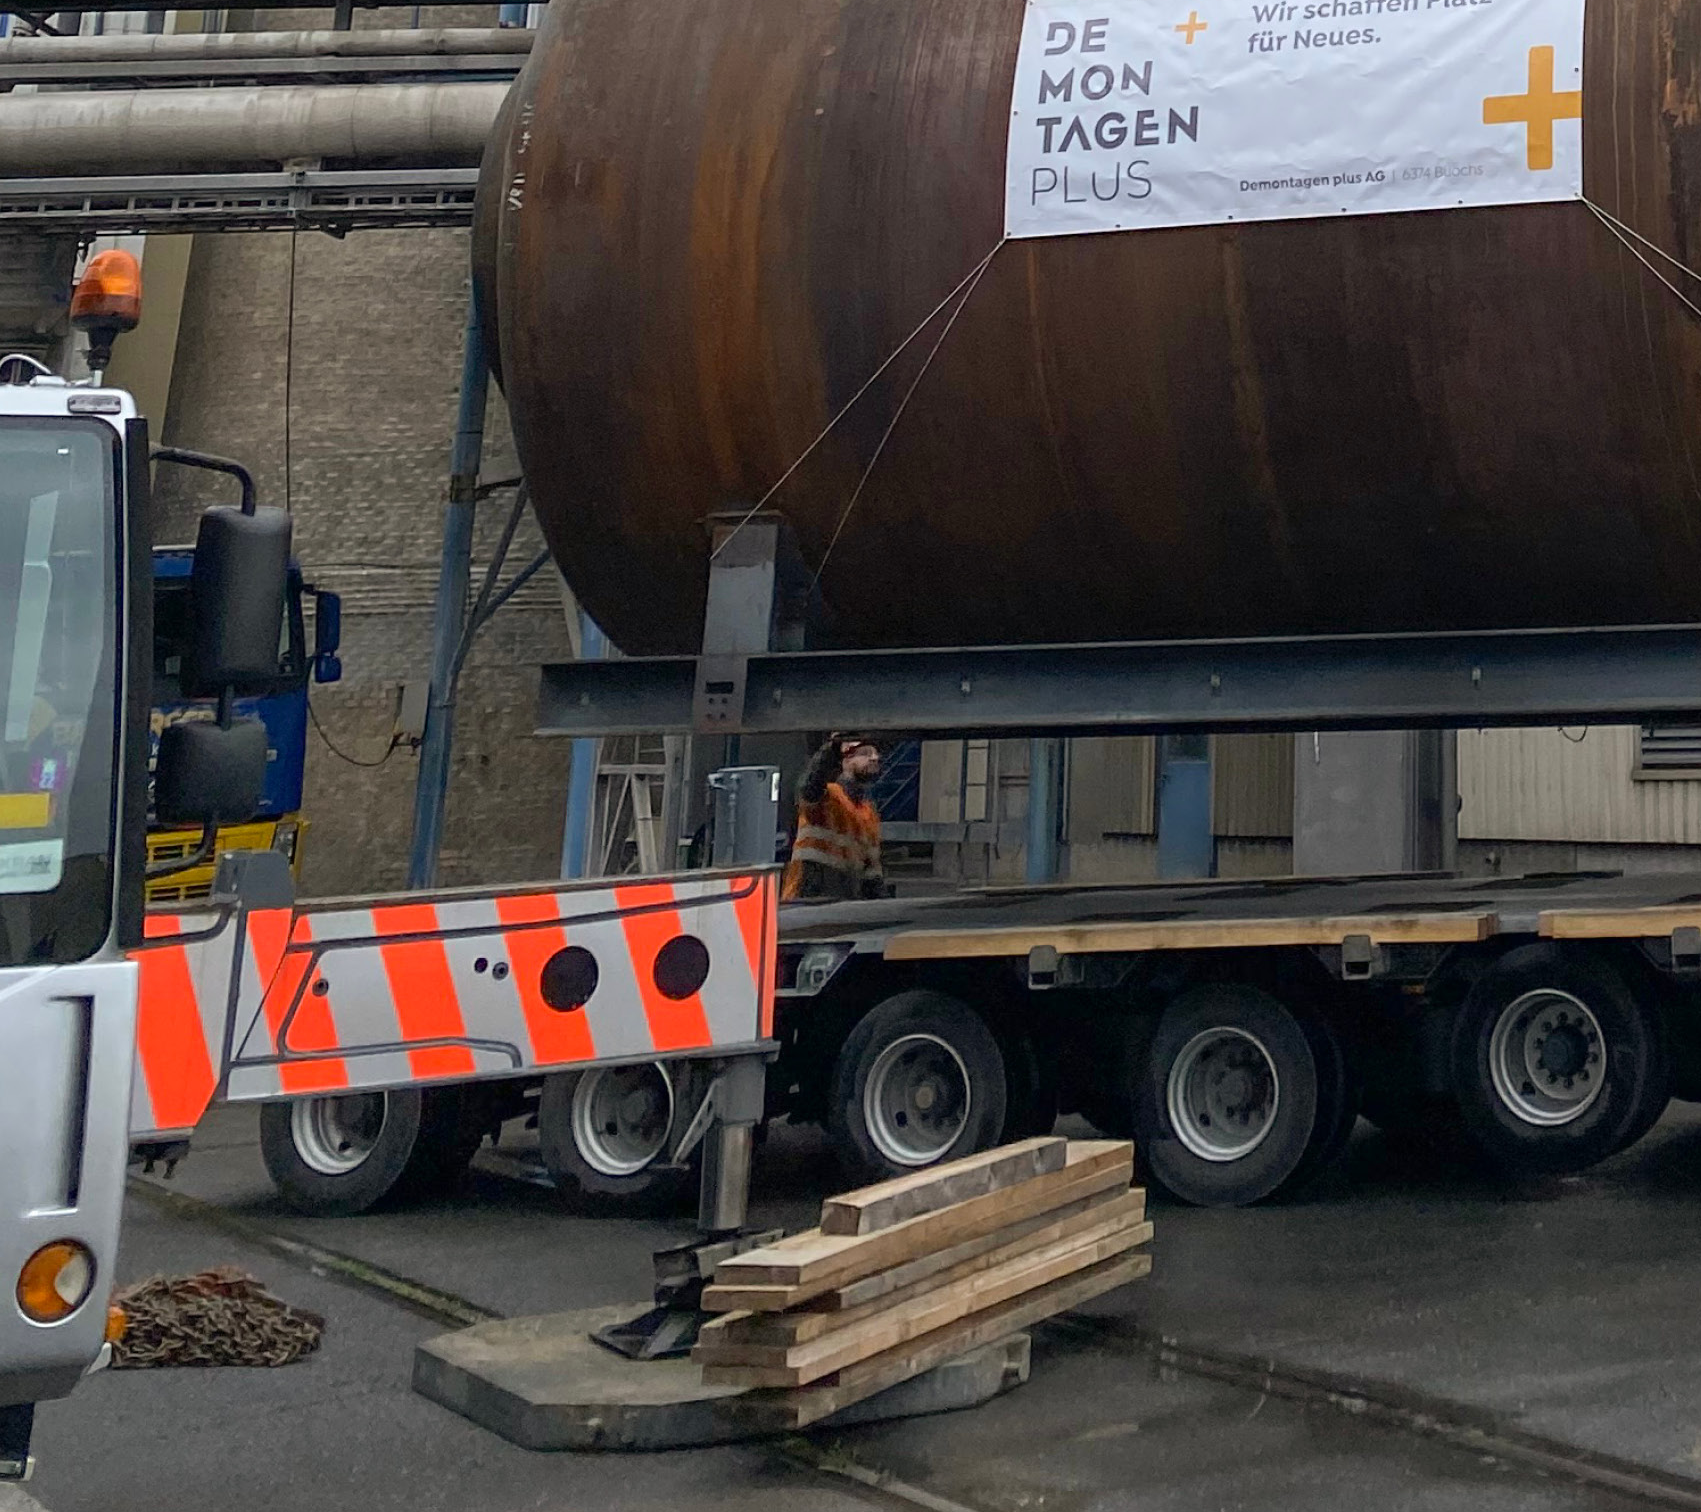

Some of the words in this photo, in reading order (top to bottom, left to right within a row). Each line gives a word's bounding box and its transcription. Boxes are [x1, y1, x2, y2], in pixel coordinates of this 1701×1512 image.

[1252, 0, 1298, 23] Wir
[1044, 18, 1110, 56] DE
[1247, 30, 1287, 54] für
[1293, 28, 1381, 50] Neues.
[1038, 60, 1153, 104] MON
[1036, 106, 1199, 154] TAGEN
[1032, 160, 1152, 206] PLUS
[1239, 174, 1330, 192] Demontagen
[1332, 171, 1362, 187] plus
[1365, 170, 1386, 183] AG
